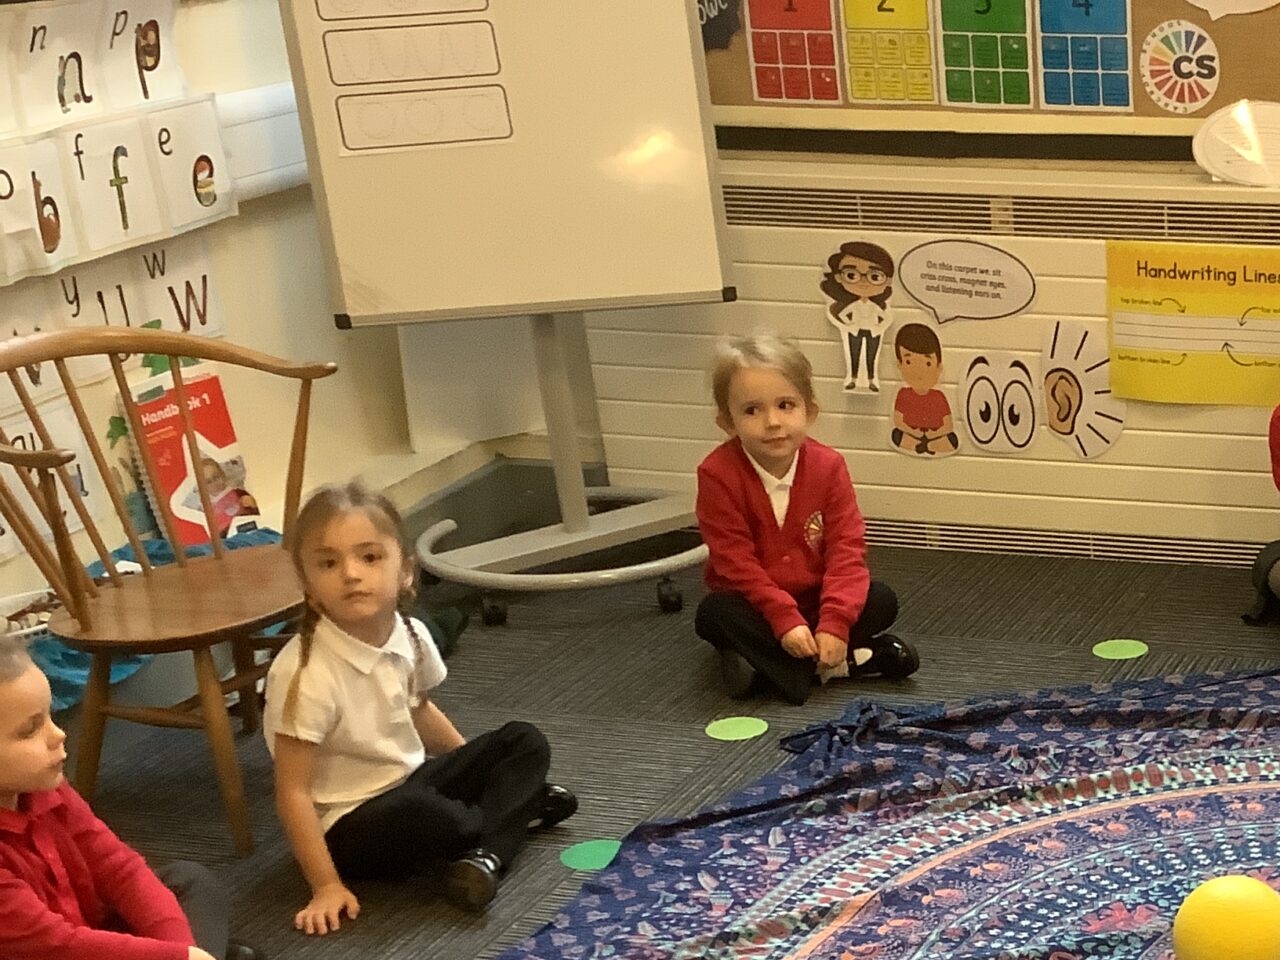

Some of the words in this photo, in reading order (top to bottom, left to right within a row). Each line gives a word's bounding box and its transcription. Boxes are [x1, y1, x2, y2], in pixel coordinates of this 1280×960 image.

[30, 24, 47, 53] n
[109, 10, 128, 50] p
[1173, 54, 1217, 80] CS
[73, 133, 85, 181] f
[158, 127, 173, 156] e
[109, 145, 128, 231] f
[1136, 260, 1237, 286] Handwriting
[141, 396, 201, 426] Handbk
[202, 393, 211, 405] 1
